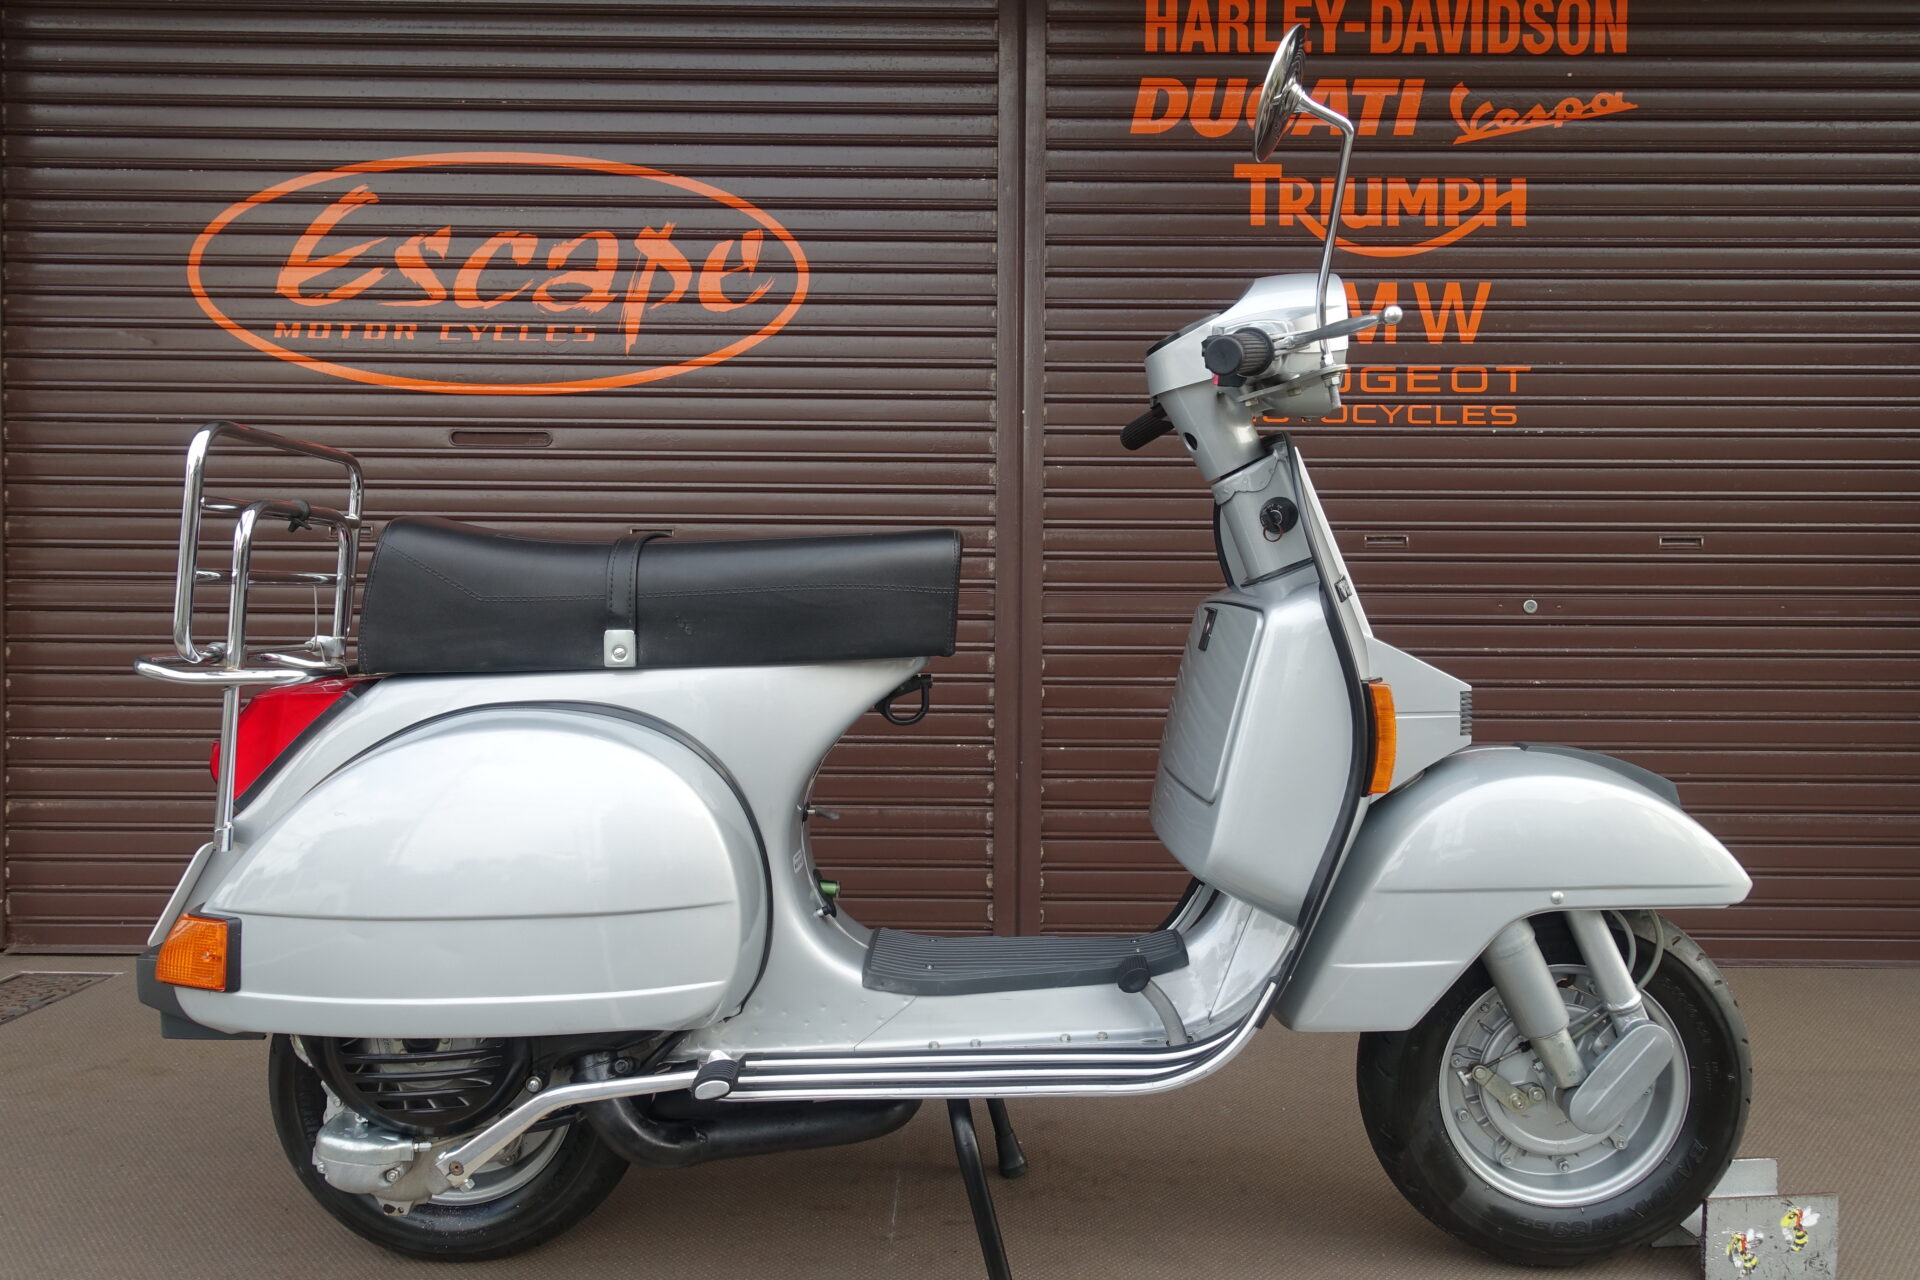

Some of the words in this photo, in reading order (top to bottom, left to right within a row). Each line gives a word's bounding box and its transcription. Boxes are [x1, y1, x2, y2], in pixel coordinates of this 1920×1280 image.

[1144, 0, 1628, 55] HARLEY-DAVIDSON
[1449, 82, 1638, 144] Vespa
[1233, 163, 1528, 256] TRIUMPH
[275, 184, 775, 356] Escape
[274, 322, 417, 340] MOTOR
[440, 324, 597, 342] CYCLES
[1343, 282, 1492, 344] MW
